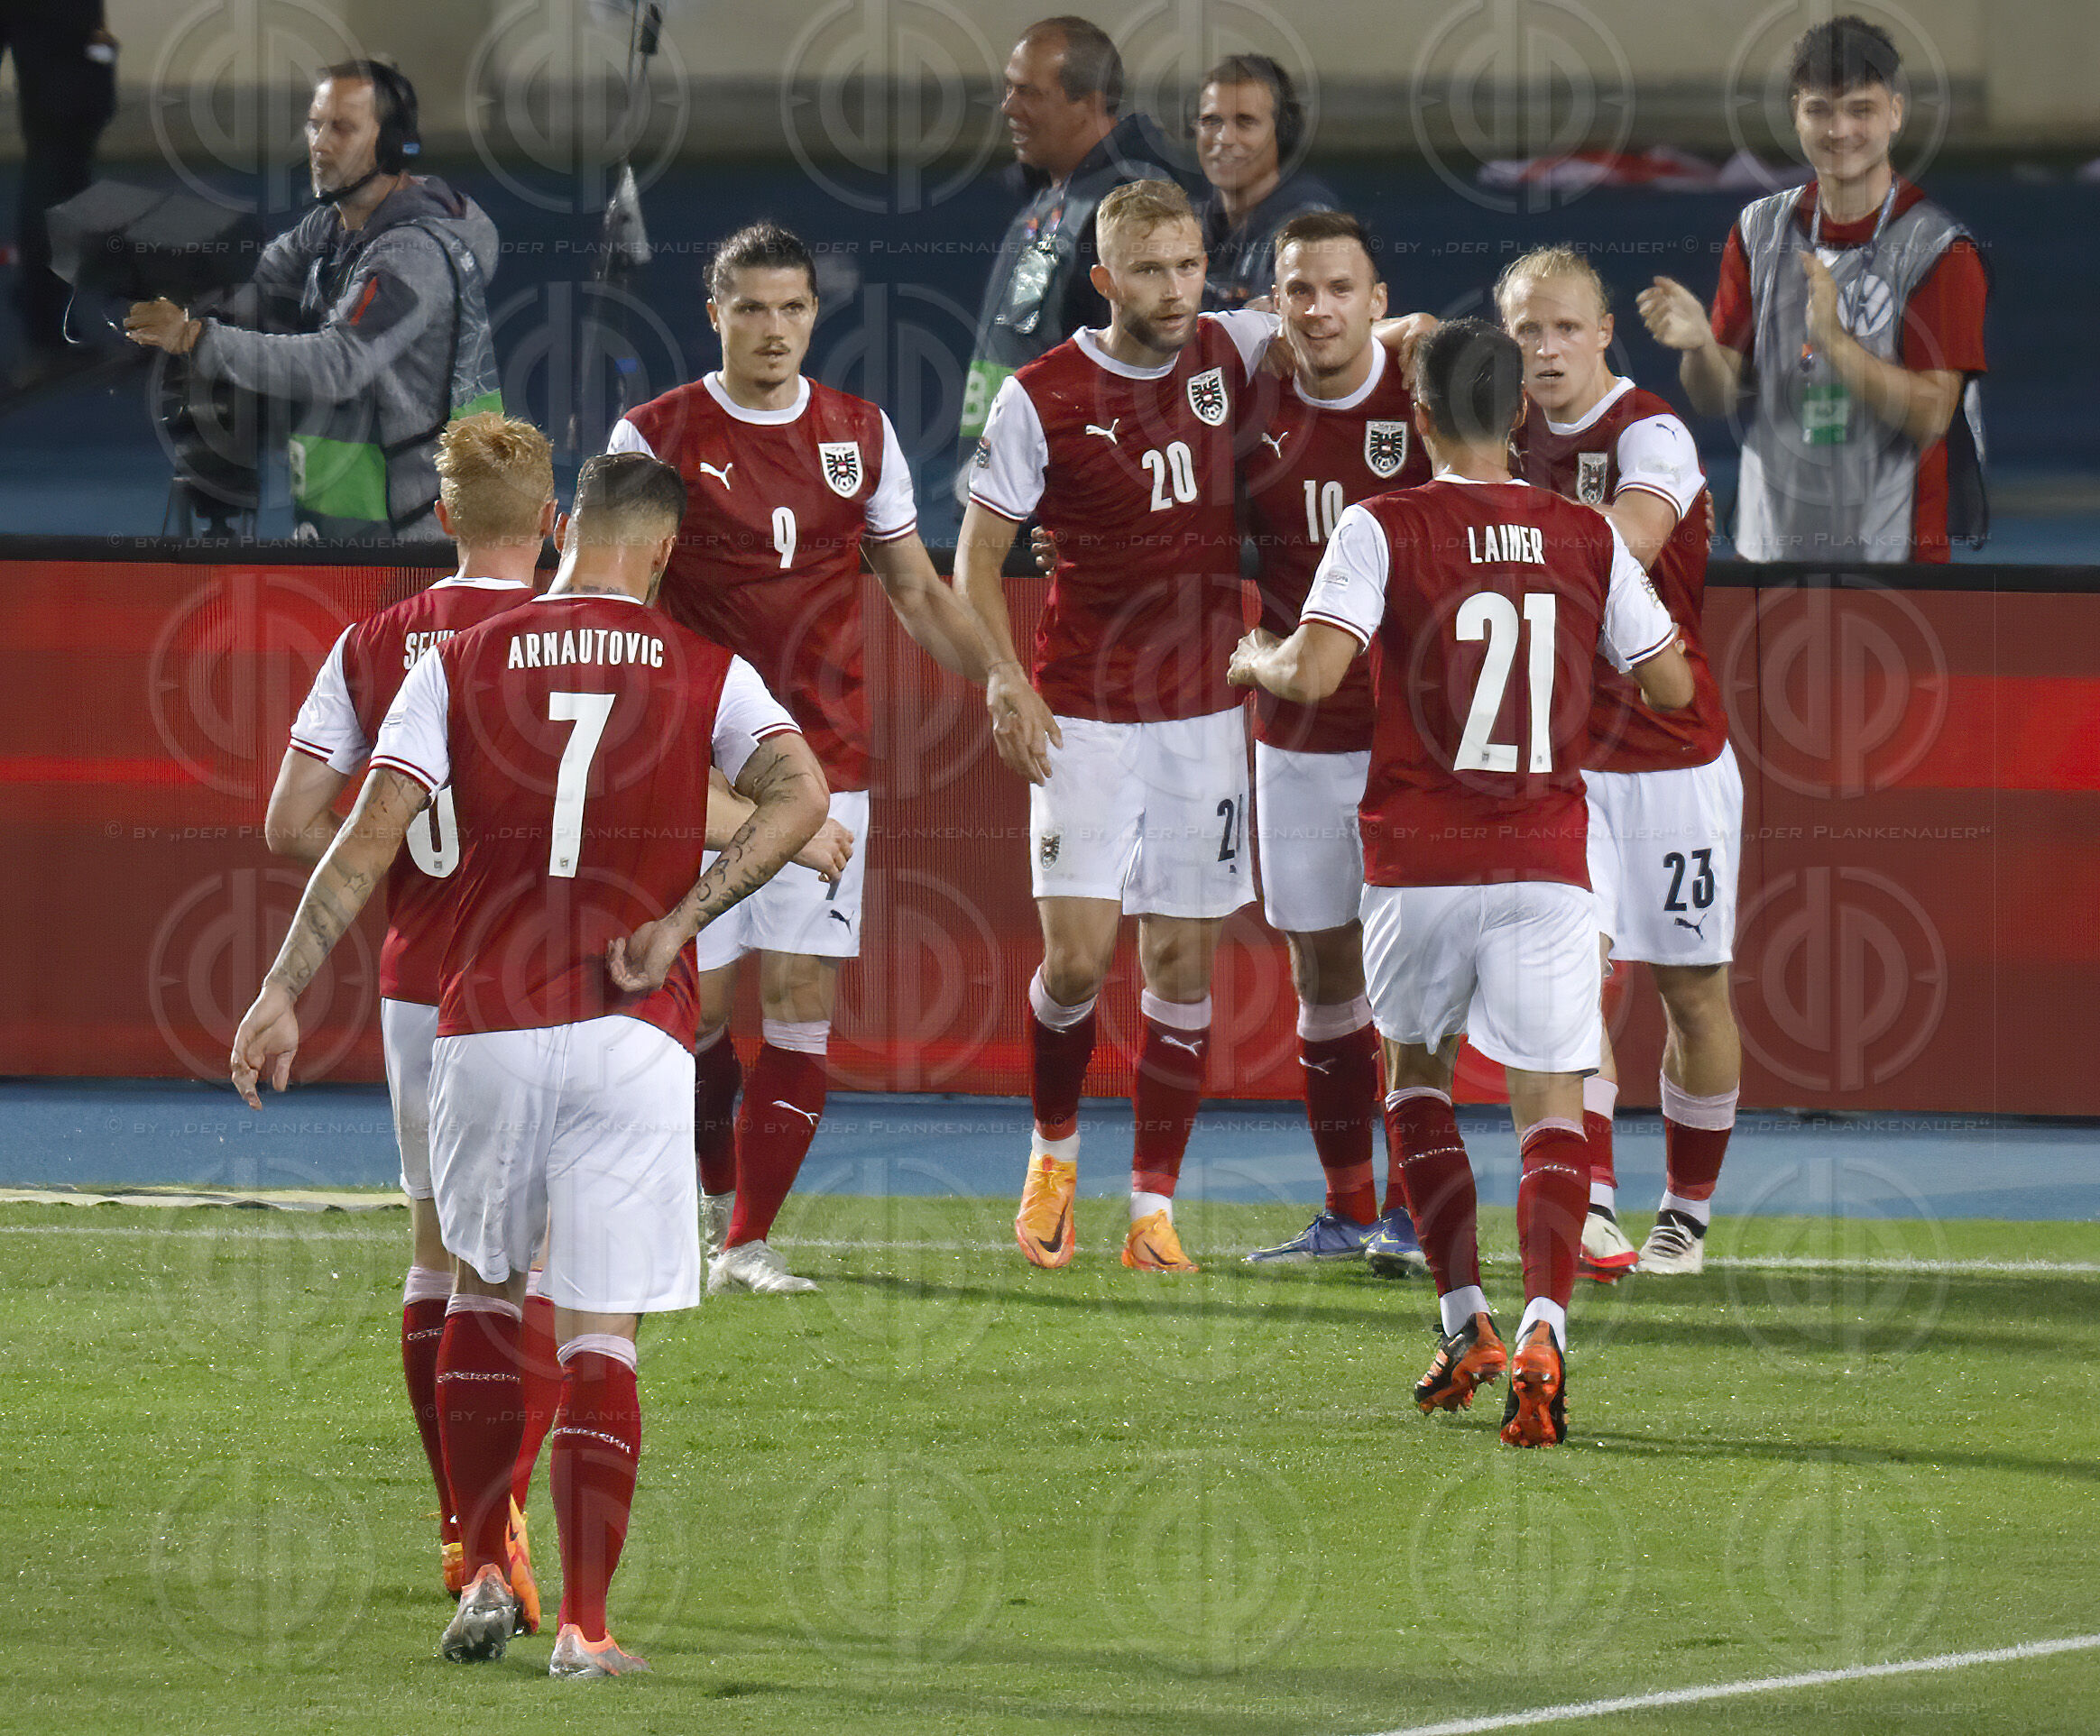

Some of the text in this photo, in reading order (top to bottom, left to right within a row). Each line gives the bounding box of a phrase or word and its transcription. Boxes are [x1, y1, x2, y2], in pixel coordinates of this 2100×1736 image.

[1142, 441, 1197, 512] 20
[772, 506, 797, 569] 9
[1303, 480, 1343, 544] 10
[508, 629, 664, 669] ARNAUTOVIC
[1453, 592, 1556, 773] 21
[548, 691, 616, 878] 7
[1662, 848, 1715, 912] 23
